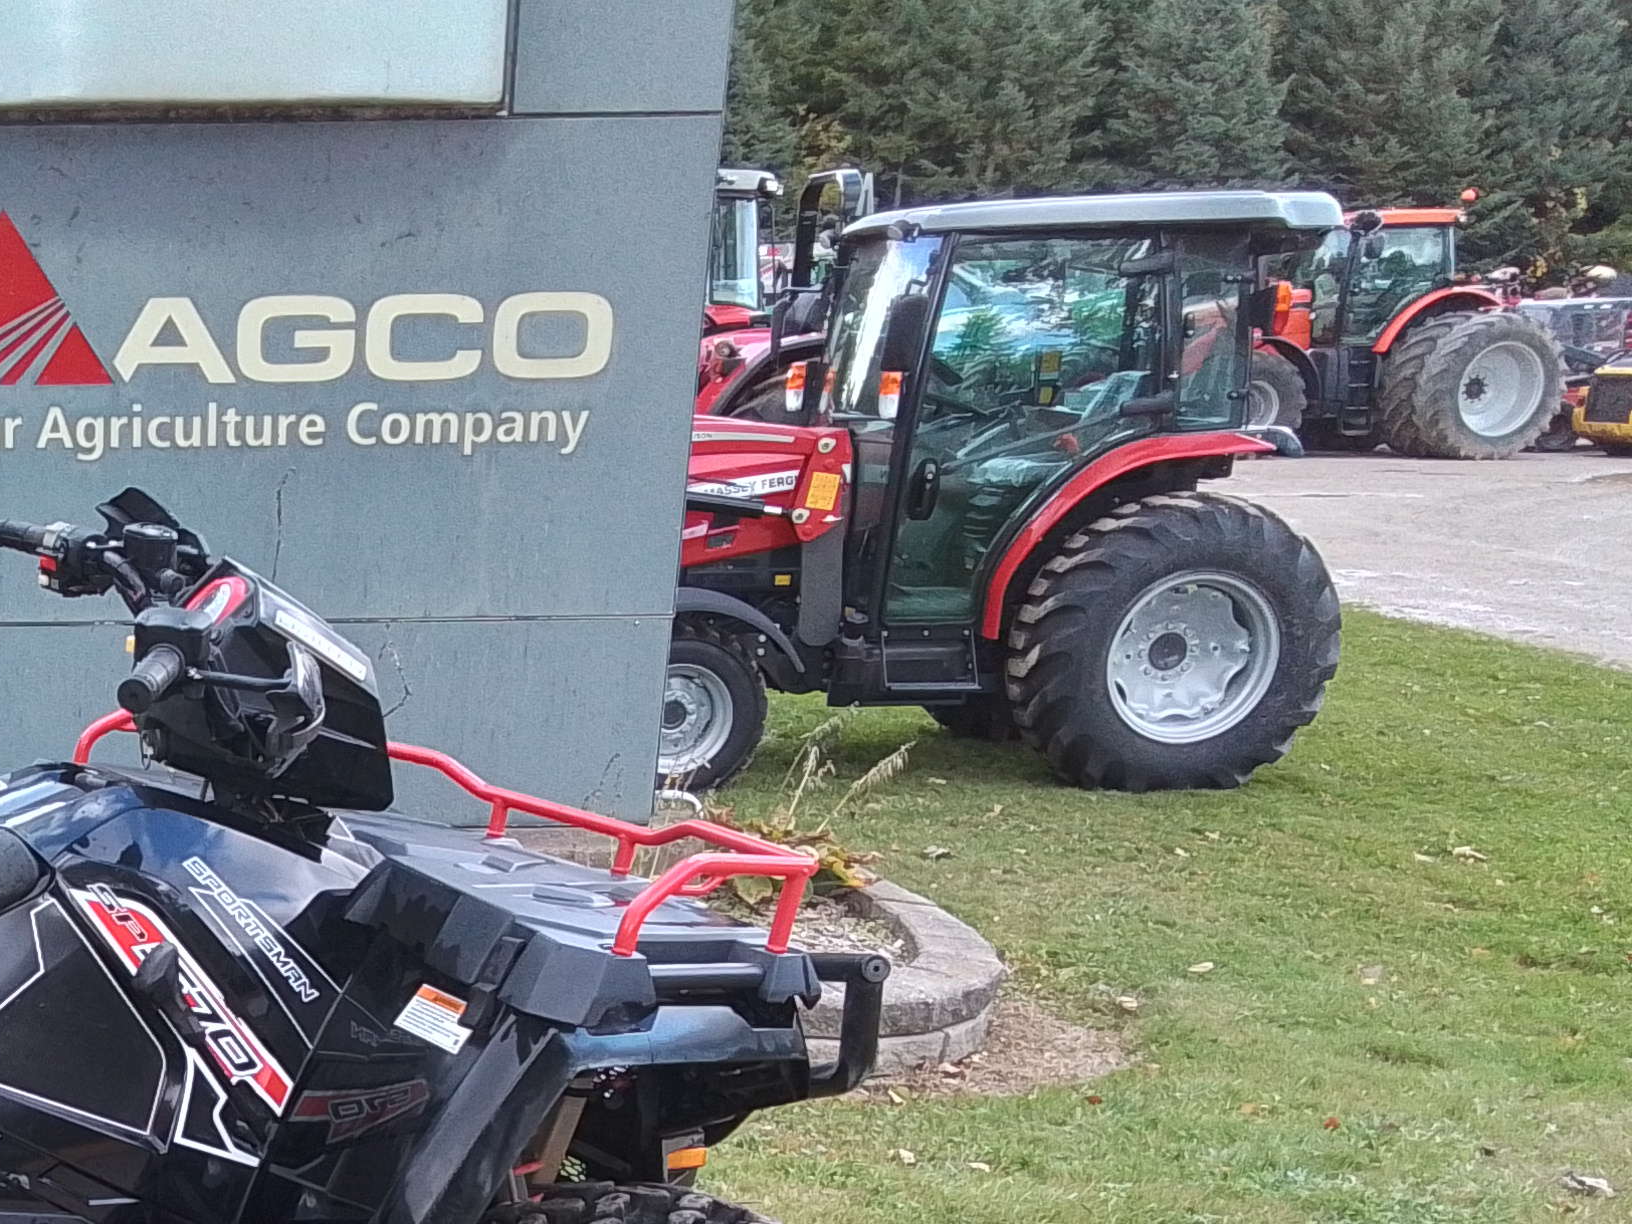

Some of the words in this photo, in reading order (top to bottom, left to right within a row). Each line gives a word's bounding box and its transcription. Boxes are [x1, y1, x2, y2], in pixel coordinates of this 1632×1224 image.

[112, 291, 613, 384] AGCO
[36, 401, 326, 461] Agriculture
[346, 401, 590, 456] Company
[86, 883, 149, 943] SP
[182, 856, 320, 1003] SPORTSMAN
